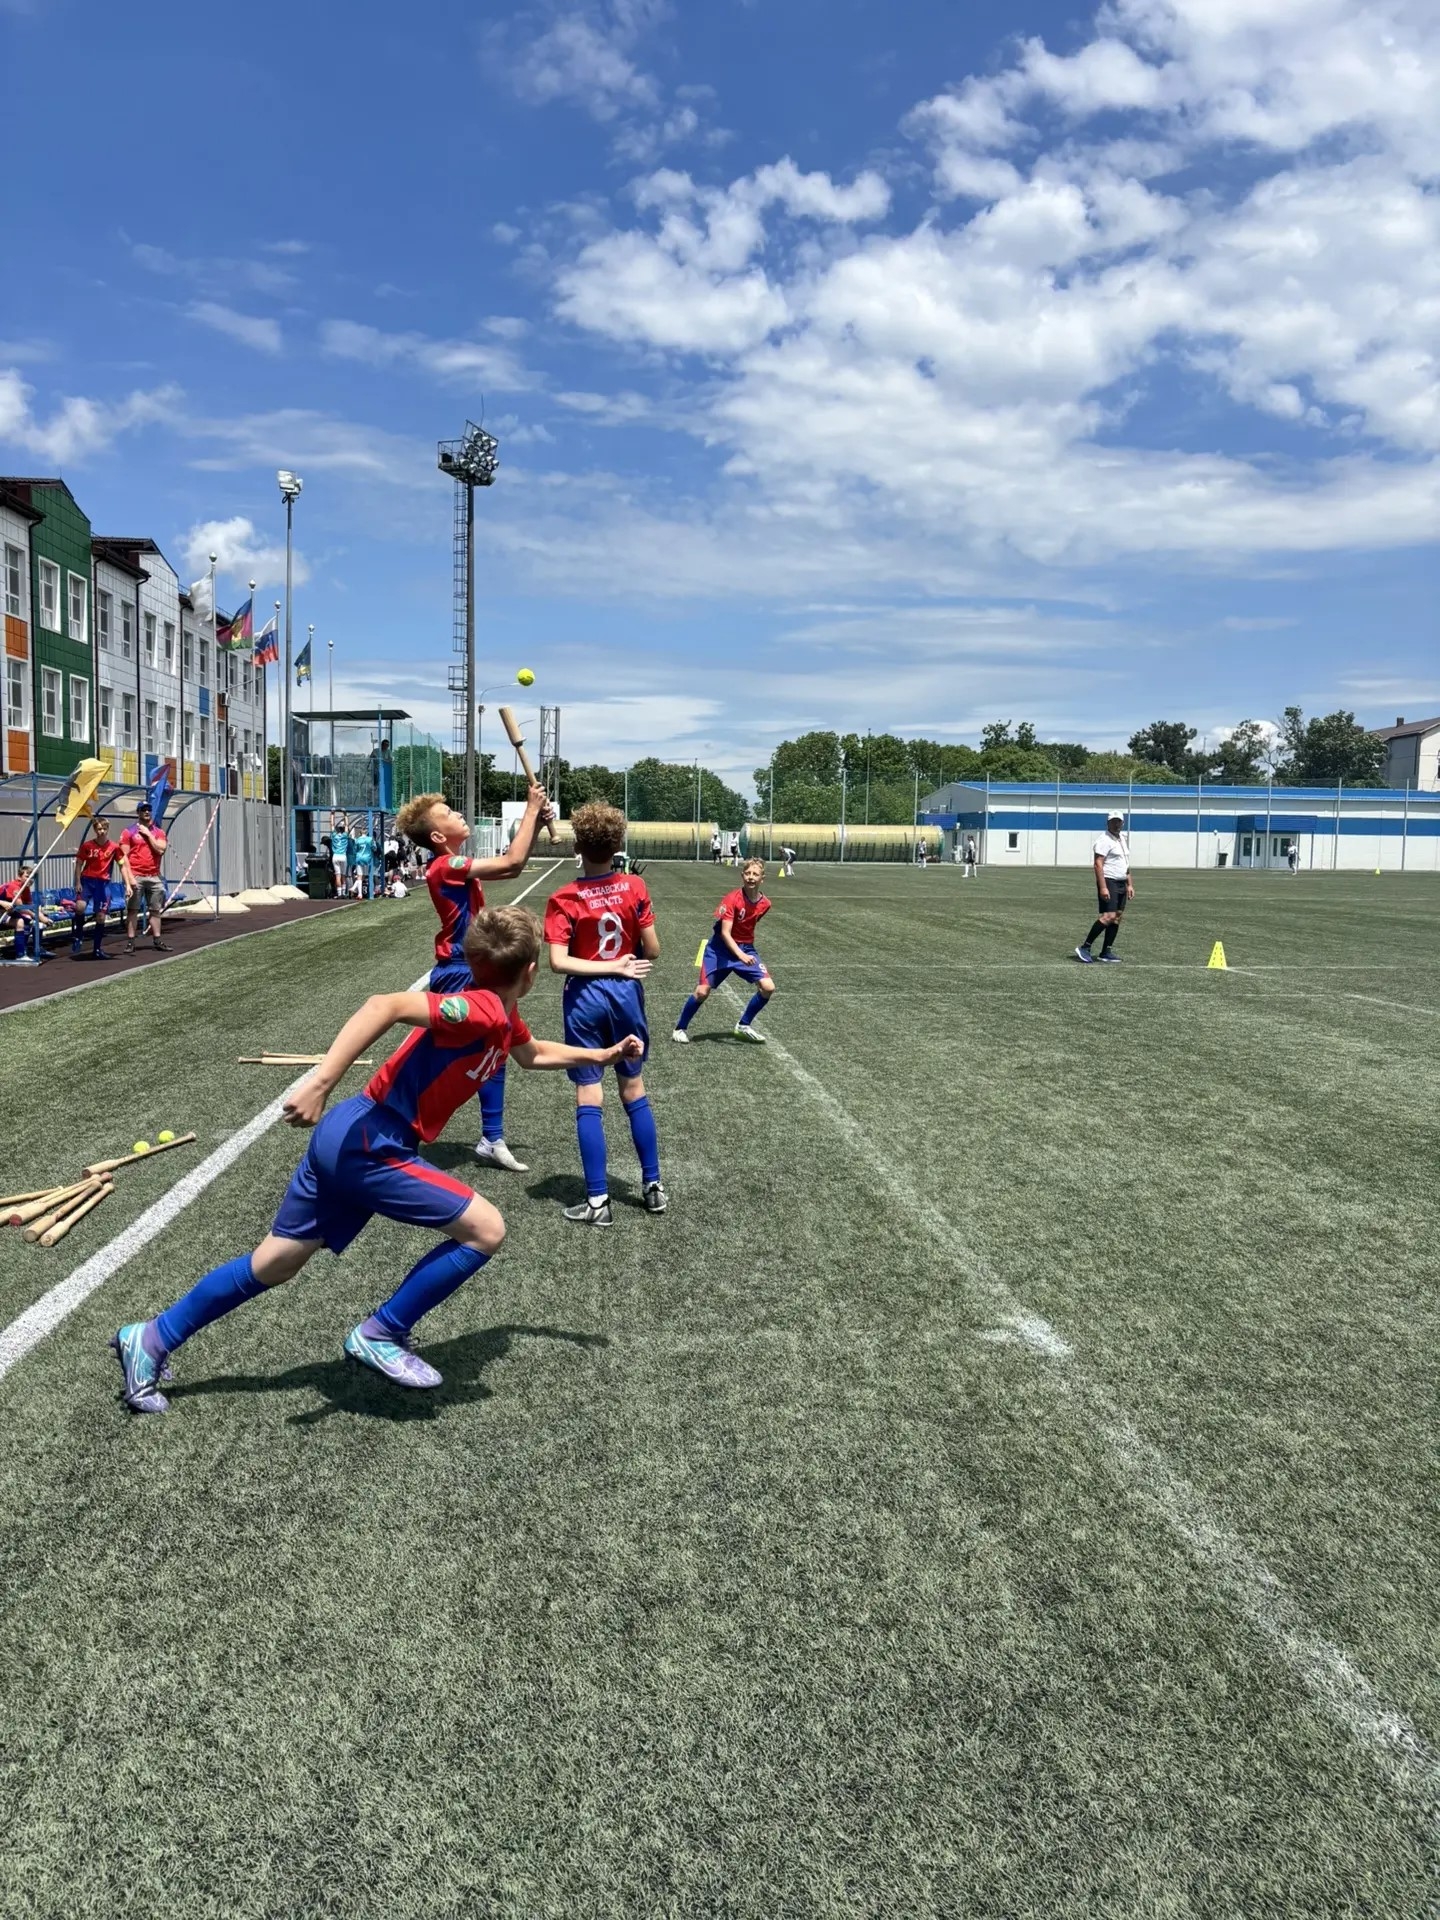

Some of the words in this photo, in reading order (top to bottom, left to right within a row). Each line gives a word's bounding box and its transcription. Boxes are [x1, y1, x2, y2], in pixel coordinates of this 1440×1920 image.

[88, 848, 99, 857] 12
[100, 901, 108, 910] 12
[598, 912, 622, 959] 8
